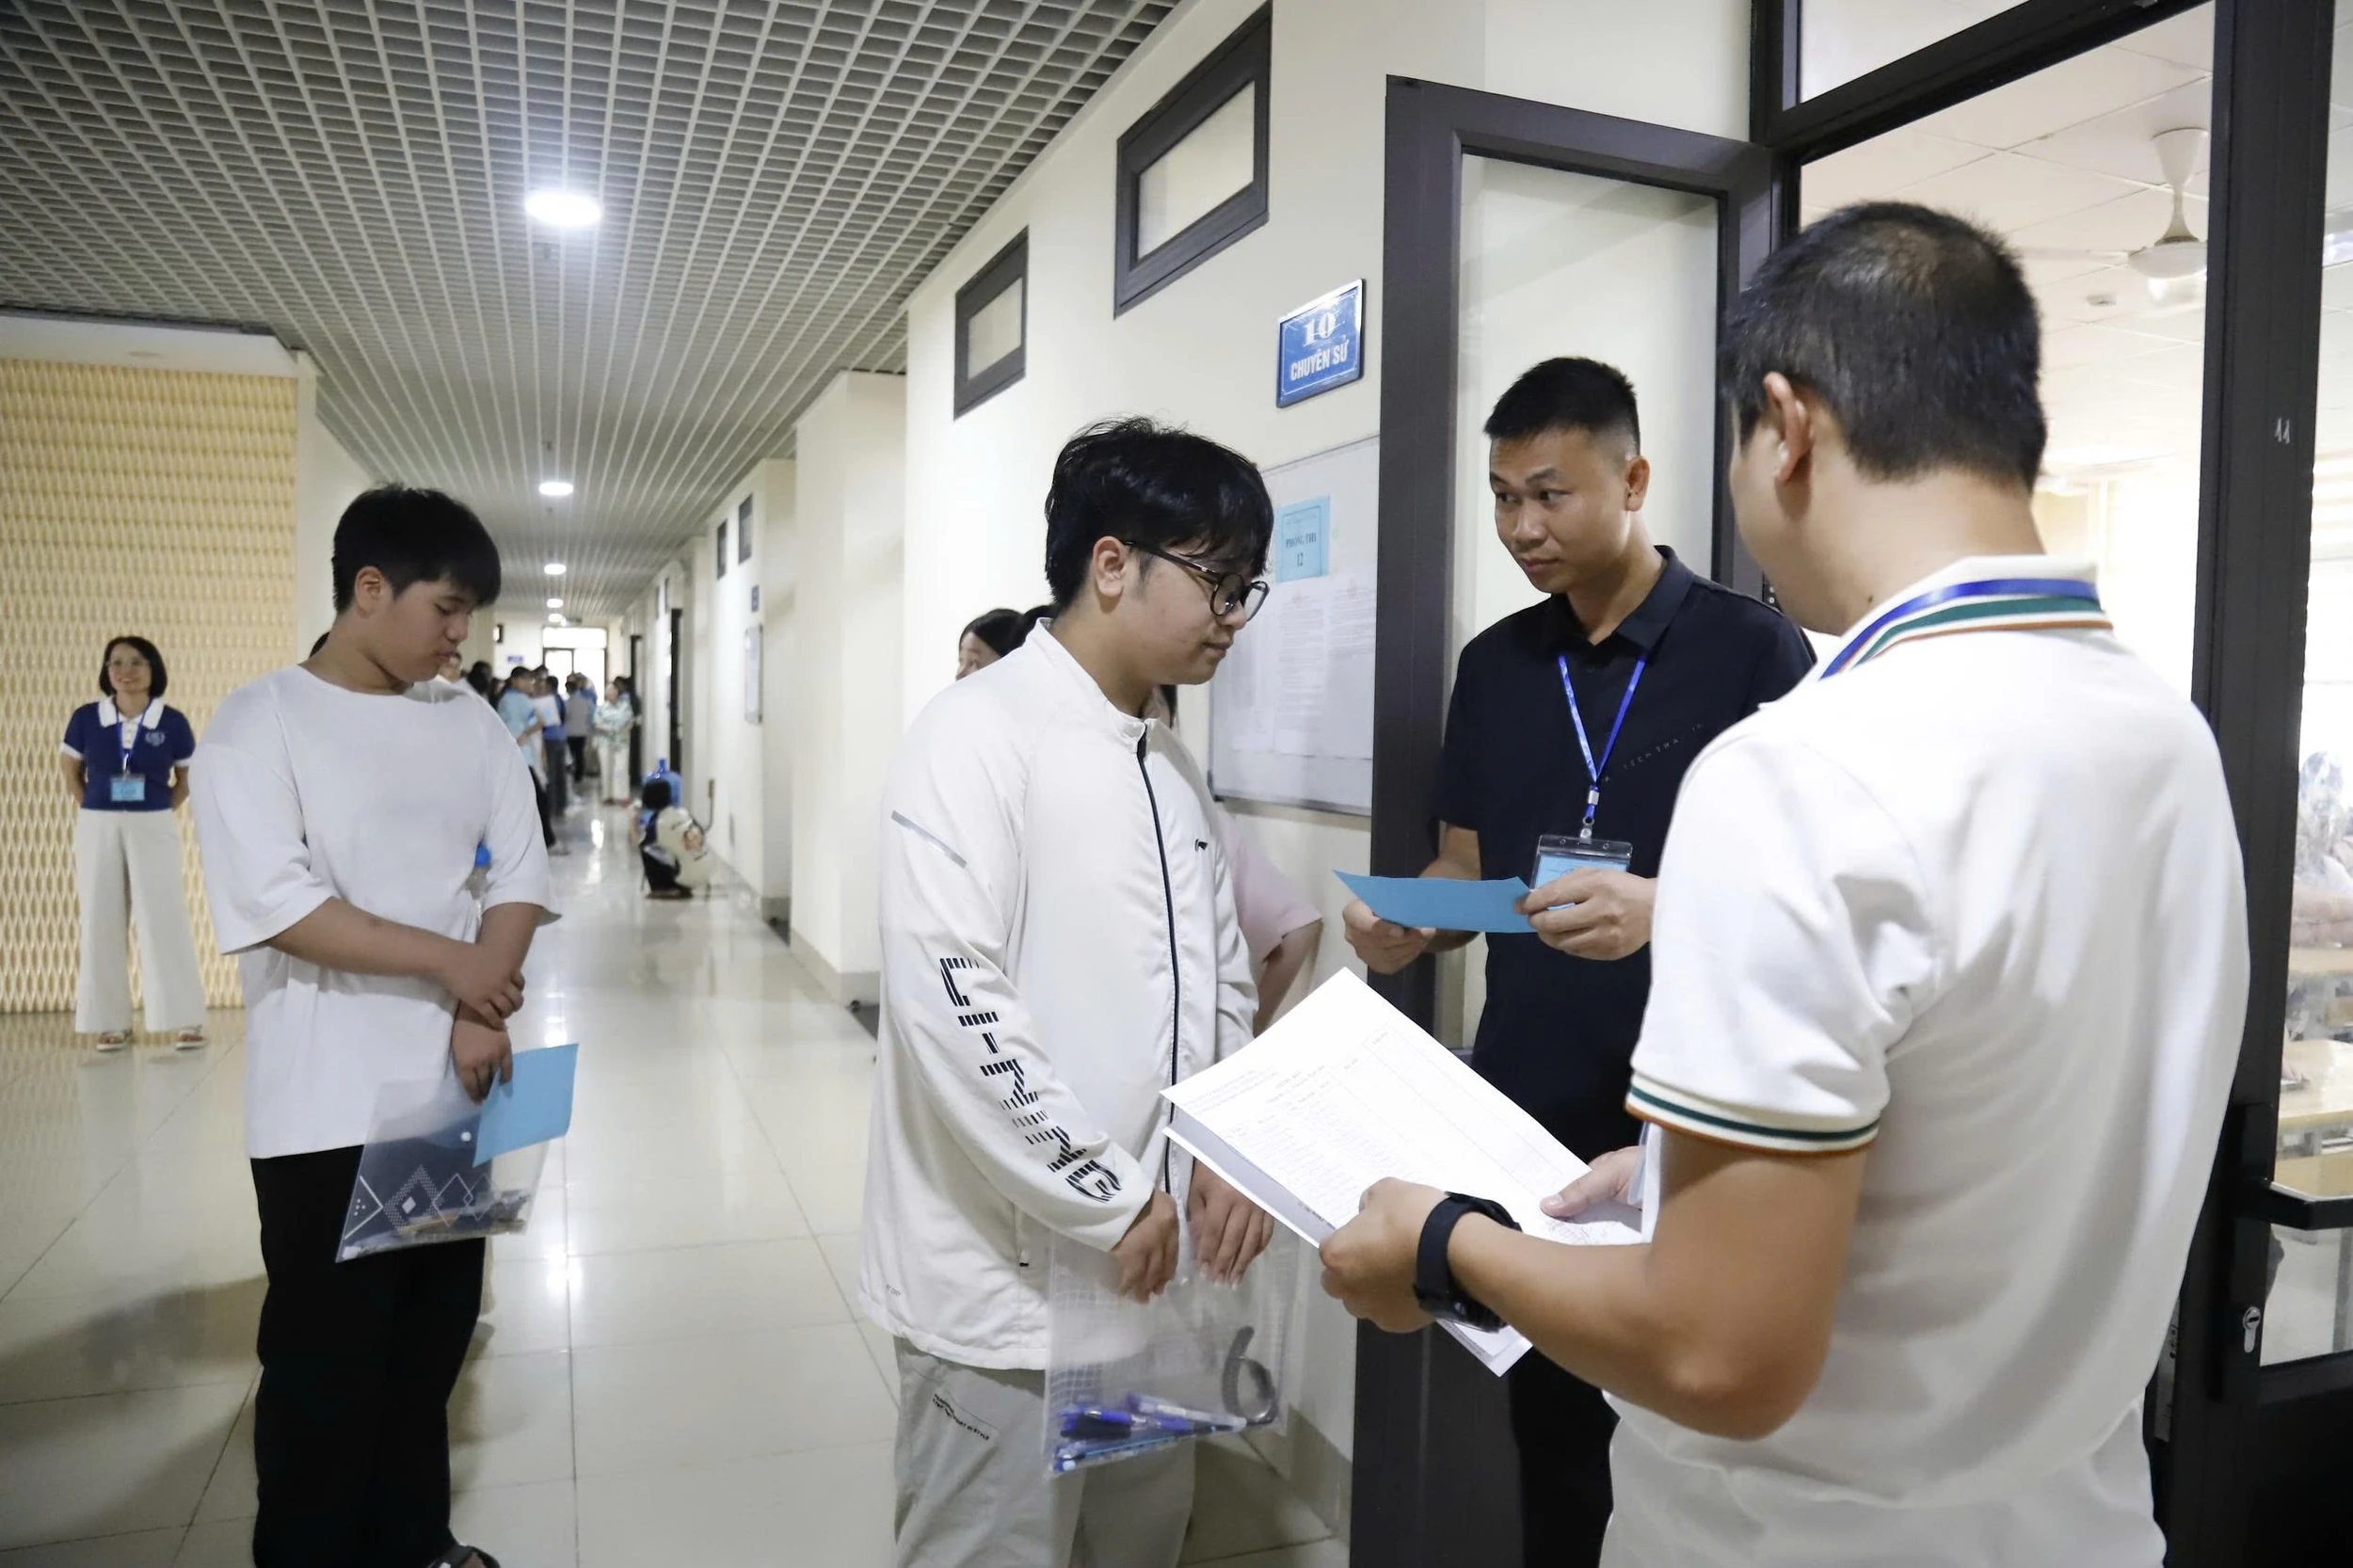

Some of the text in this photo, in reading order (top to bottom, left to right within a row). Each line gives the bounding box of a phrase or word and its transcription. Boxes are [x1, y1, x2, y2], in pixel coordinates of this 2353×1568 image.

[1303, 312, 1337, 346] 10
[1290, 349, 1331, 381] CHUYÊN
[939, 957, 1122, 1204] LI-NING
